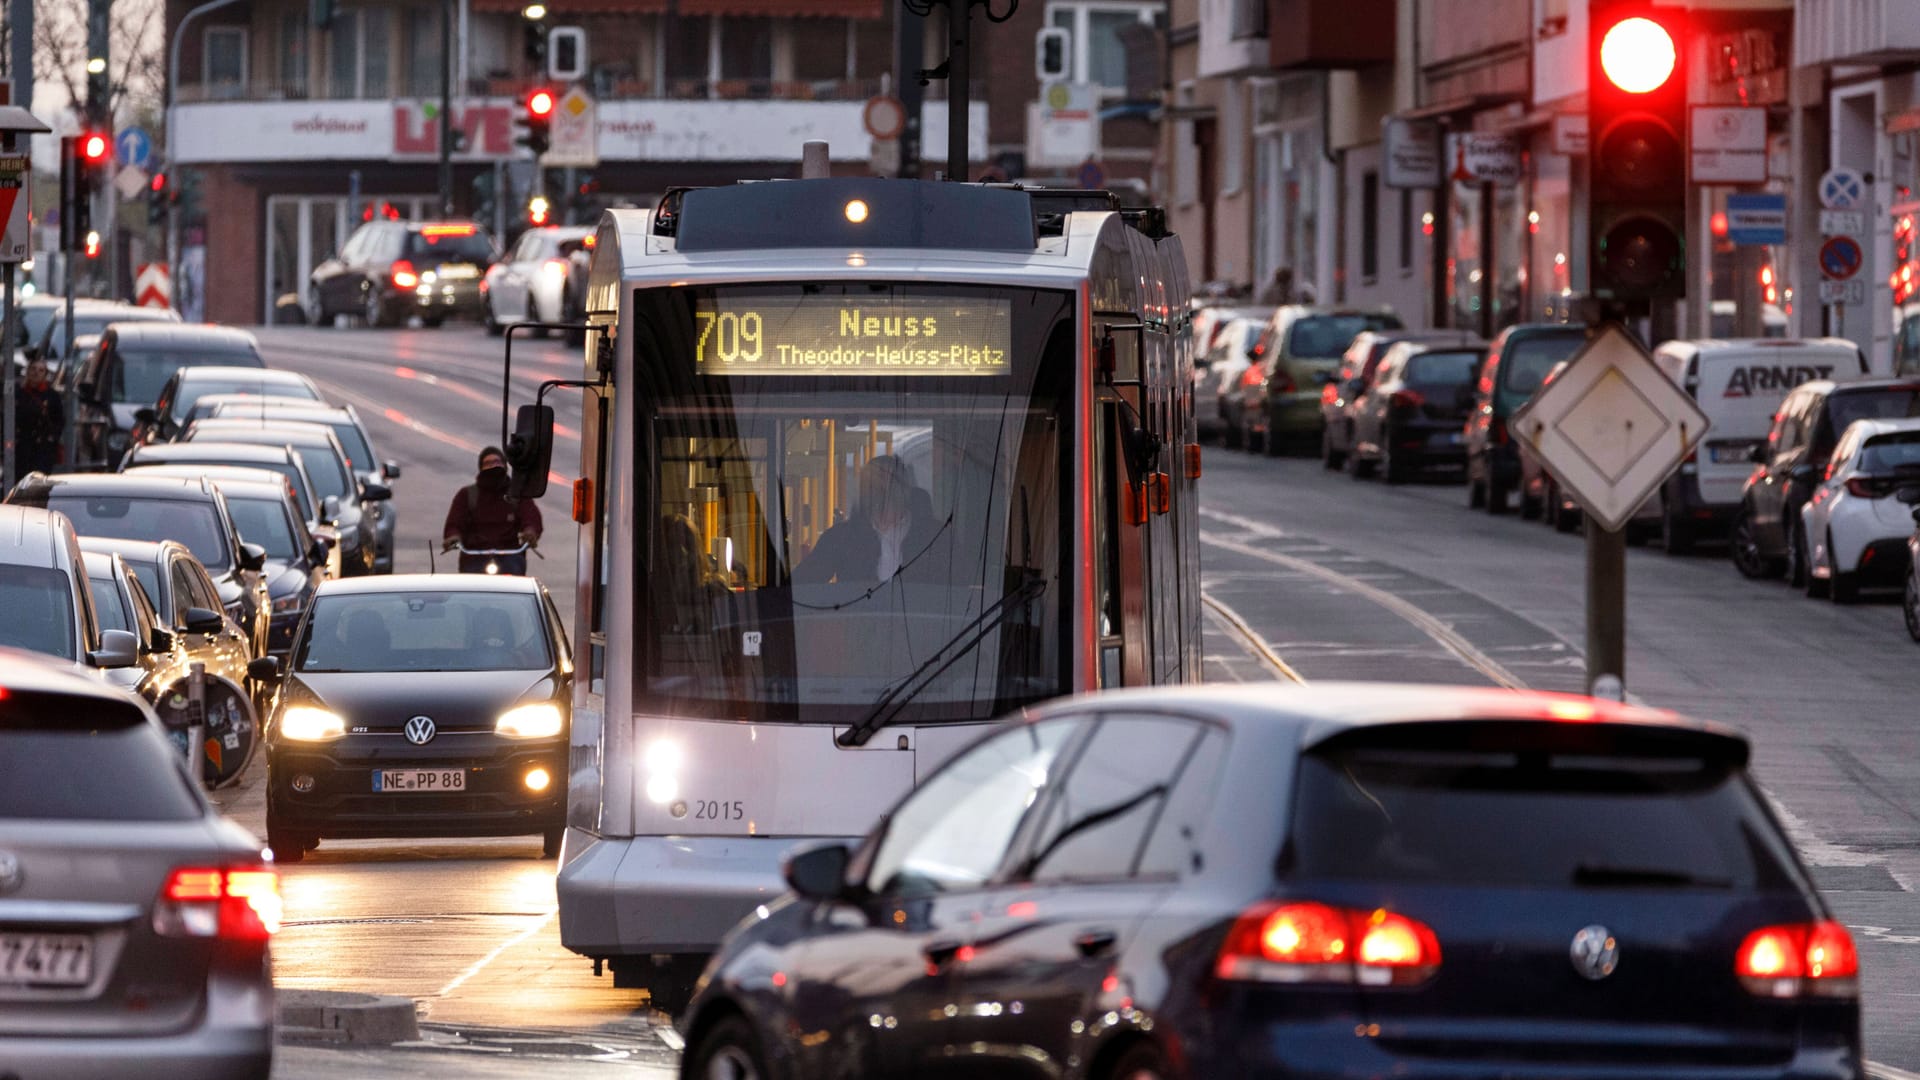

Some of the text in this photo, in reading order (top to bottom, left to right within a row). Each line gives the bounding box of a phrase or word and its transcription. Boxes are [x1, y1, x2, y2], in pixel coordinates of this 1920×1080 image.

[695, 312, 762, 362] 709
[840, 309, 937, 337] Neuss
[776, 344, 1004, 366] Theodor-Heuss-Platz
[1725, 365, 1834, 397] ARNDT
[384, 772, 462, 788] NE PP 88
[695, 800, 743, 820] 2015
[2, 938, 84, 974] 7477
